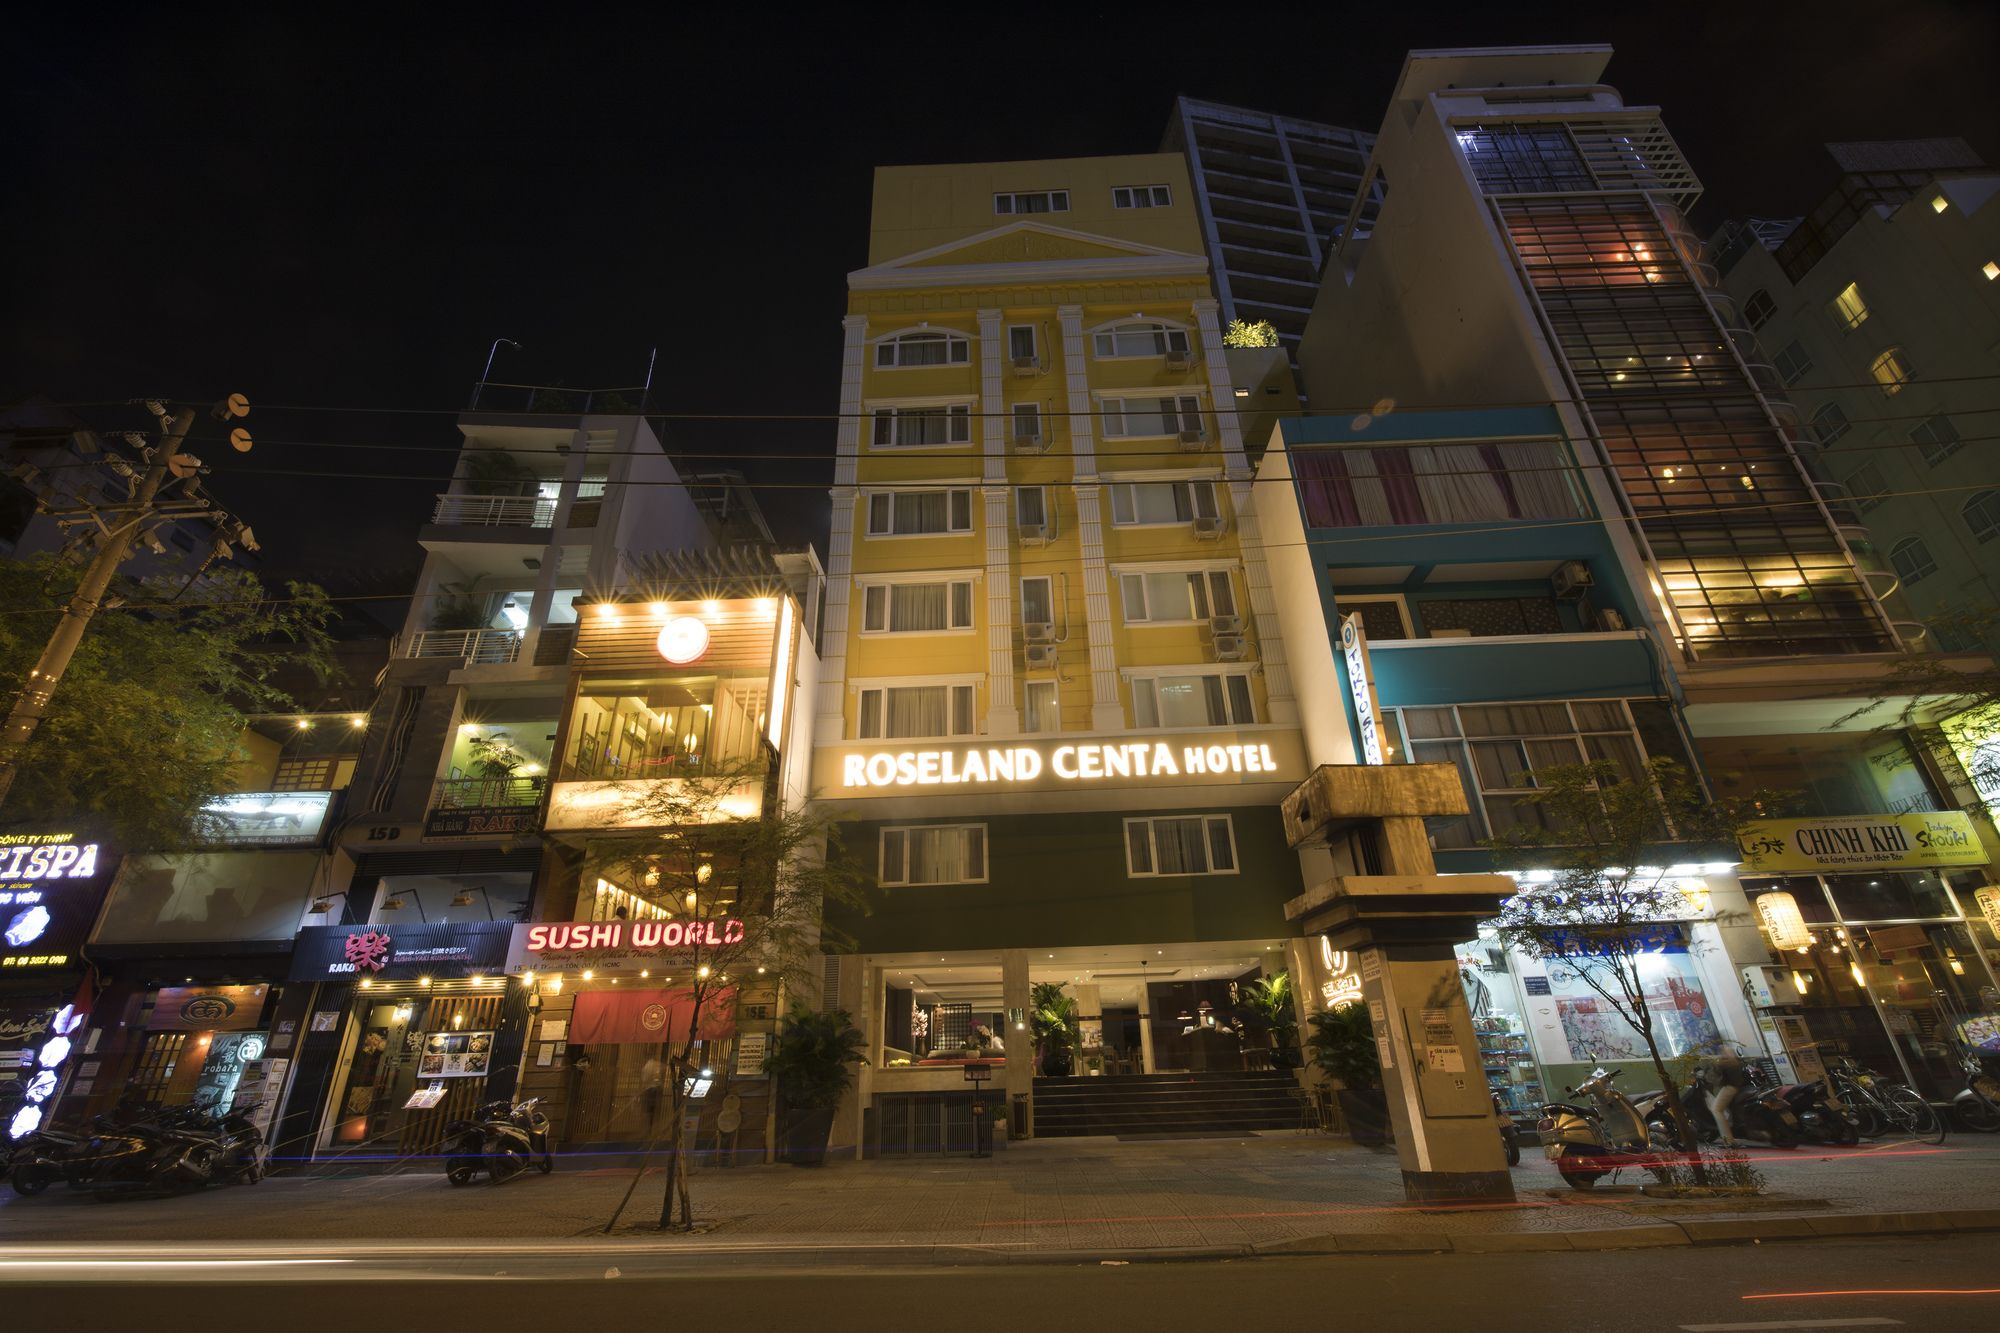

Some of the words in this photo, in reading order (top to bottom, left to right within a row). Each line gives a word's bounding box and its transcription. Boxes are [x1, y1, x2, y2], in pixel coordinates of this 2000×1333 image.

[843, 748, 1042, 788] ROSELAND
[1052, 743, 1179, 780] CENTA
[1185, 744, 1277, 774] HOTEL
[42, 833, 73, 844] TNHH
[1796, 825, 1866, 856] CHÍNH
[1865, 822, 1911, 852] KHÍ
[527, 924, 622, 950] SUSHI
[632, 919, 744, 947] WORLD
